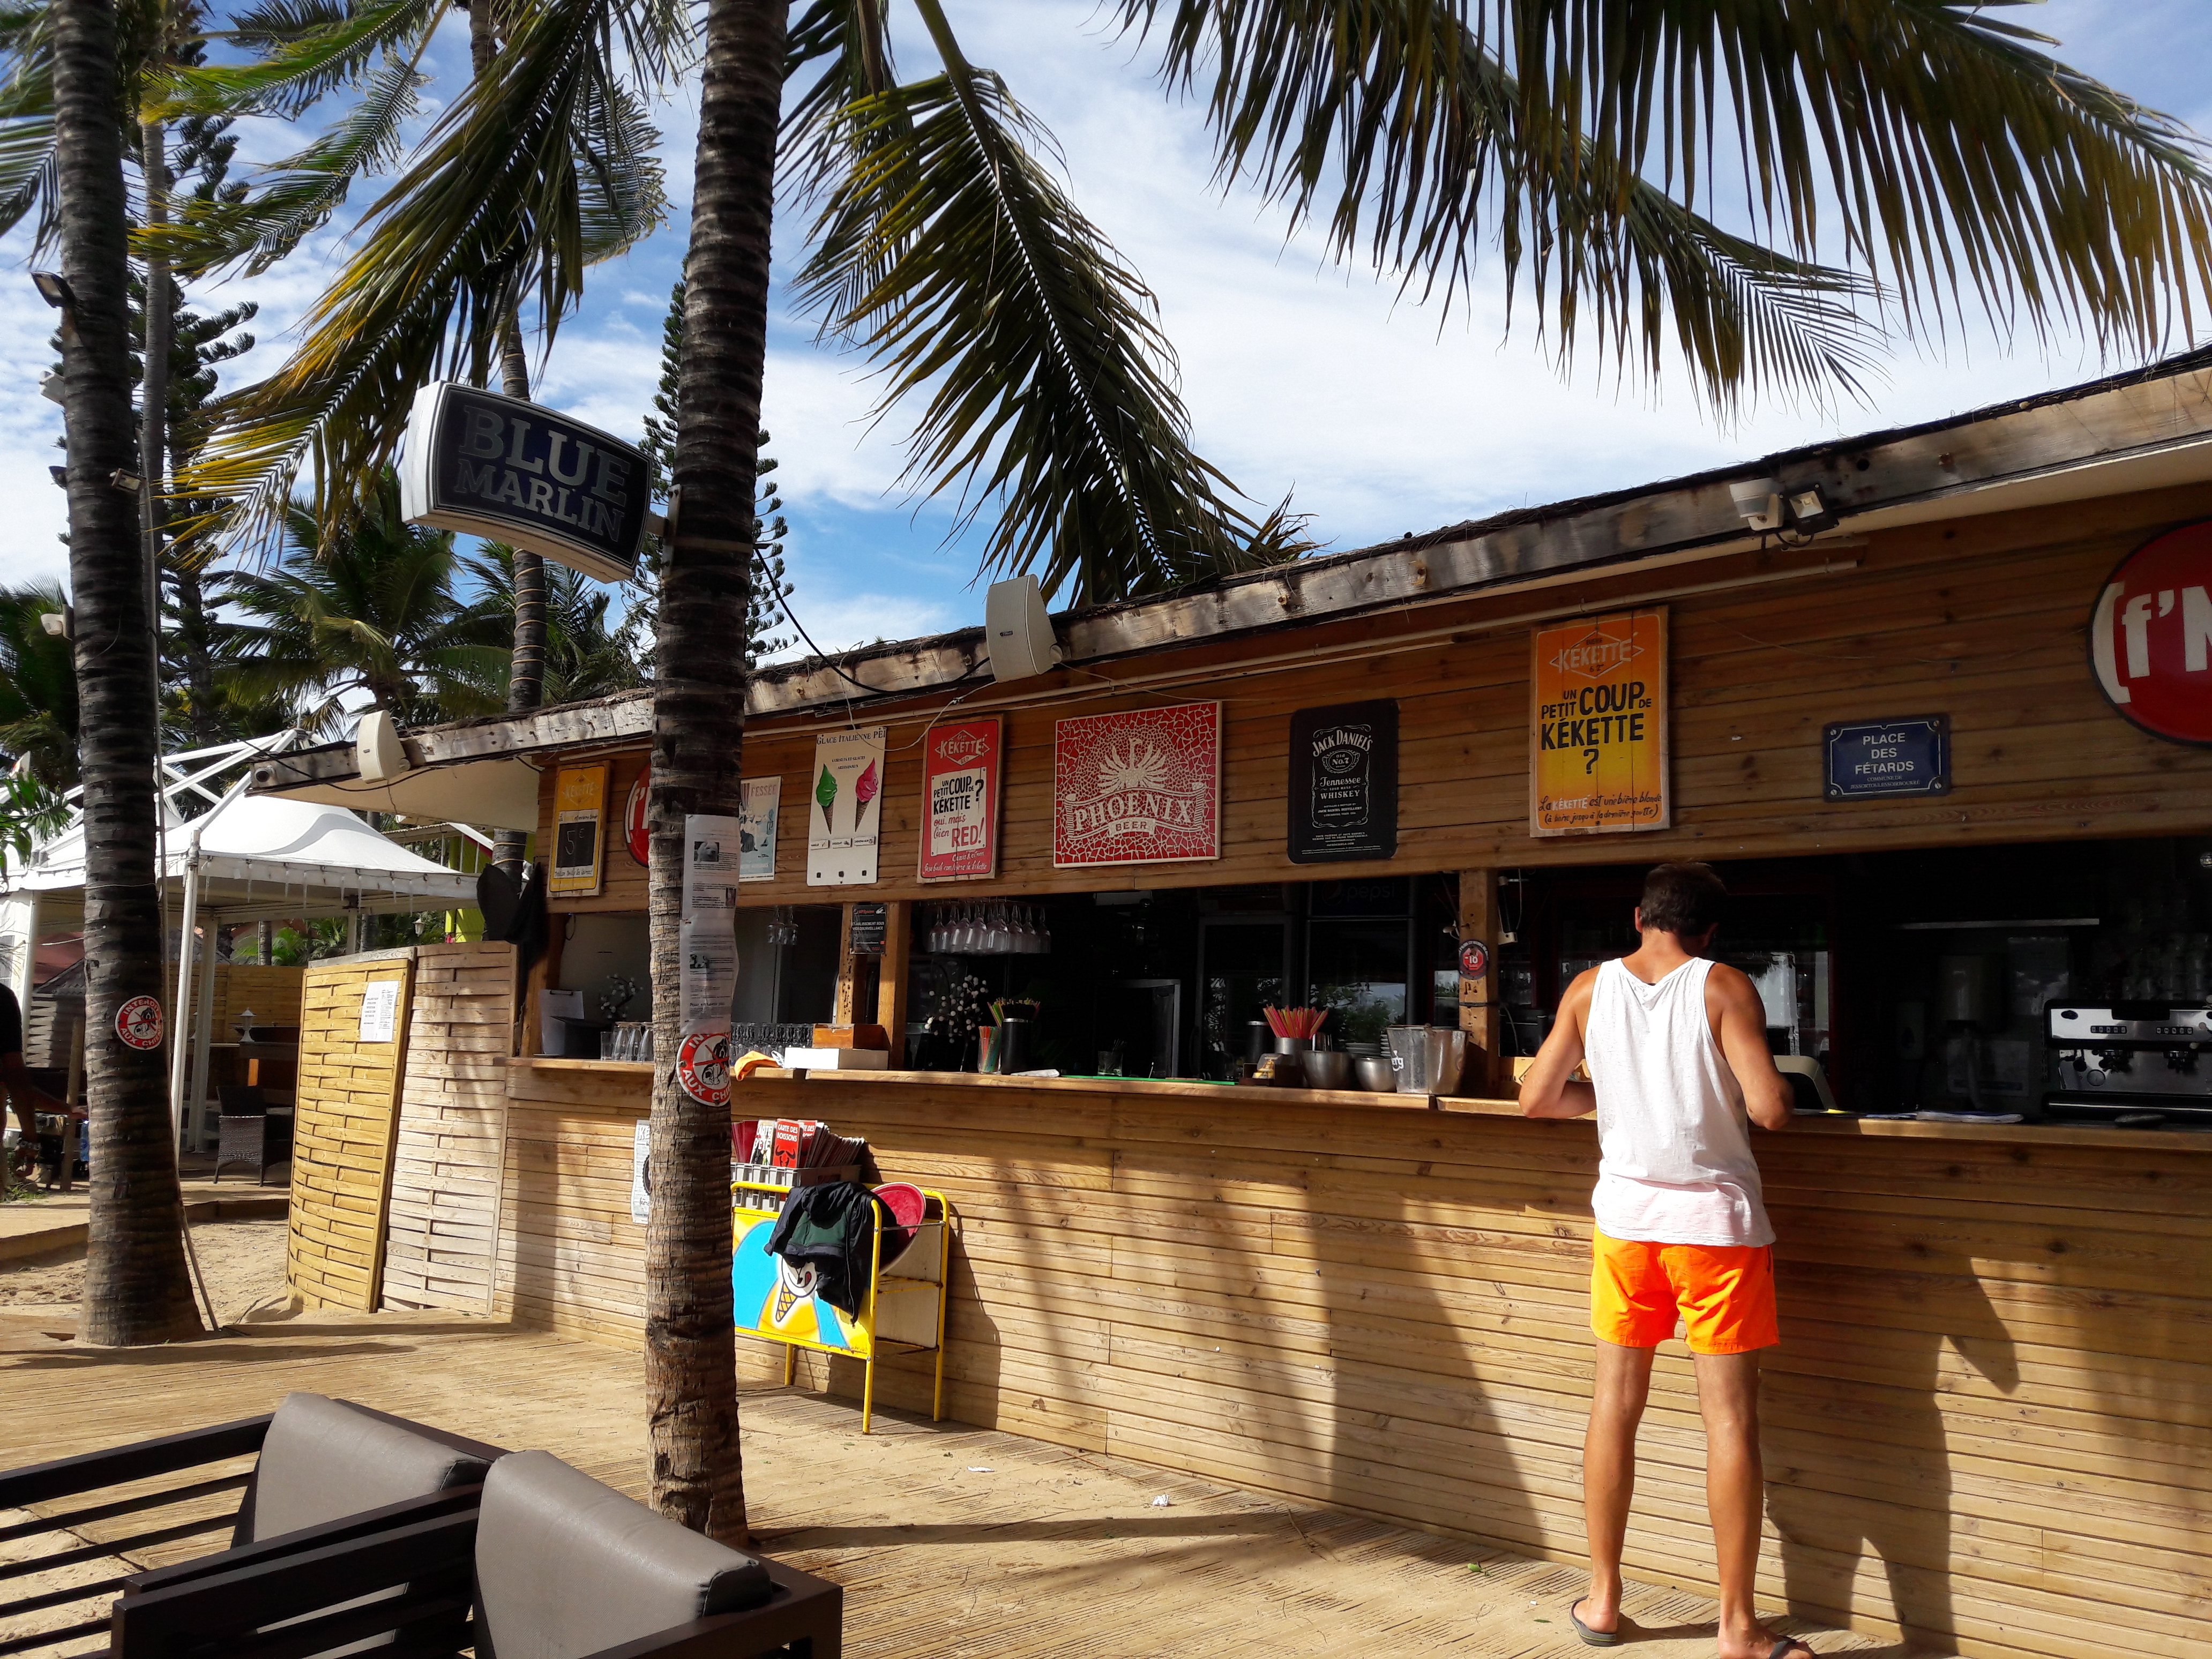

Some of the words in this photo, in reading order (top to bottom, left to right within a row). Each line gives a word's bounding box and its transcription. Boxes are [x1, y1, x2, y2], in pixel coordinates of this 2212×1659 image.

[459, 405, 631, 507] BLUE
[454, 459, 625, 542] MARLIN
[1541, 701, 1577, 720] PETIT
[1580, 681, 1645, 715] COUP
[1638, 698, 1651, 708] DE
[1563, 689, 1577, 700] UN
[1541, 713, 1645, 750] KÉKETTE
[1863, 732, 1906, 746] PLACE
[817, 736, 837, 745] GLACE
[1311, 734, 1336, 757] JACK
[1336, 729, 1374, 752] DANIEL'S
[1871, 747, 1897, 759] DES
[1583, 749, 1600, 774] ?
[1855, 760, 1915, 775] FÉTARDS
[933, 787, 948, 798] PETIT
[949, 775, 972, 795] COUP
[1319, 776, 1362, 787] Tennessee
[1320, 789, 1361, 800] WHISKEY
[1589, 794, 1604, 807] est
[933, 795, 971, 816] KÉKETTE
[1074, 792, 1195, 832] PHOENIX
[948, 812, 967, 825] mais
[933, 827, 950, 839] bien
[1116, 821, 1147, 832] BEER
[1347, 883, 1396, 903] pepsi
[123, 999, 160, 1015] INTERDIT
[120, 1028, 138, 1044] AUX
[682, 1069, 706, 1096] AUX
[757, 1124, 773, 1137] CARTE
[777, 1124, 790, 1132] CARTE
[790, 1126, 798, 1134] DES
[776, 1132, 798, 1142] BOISSONS
